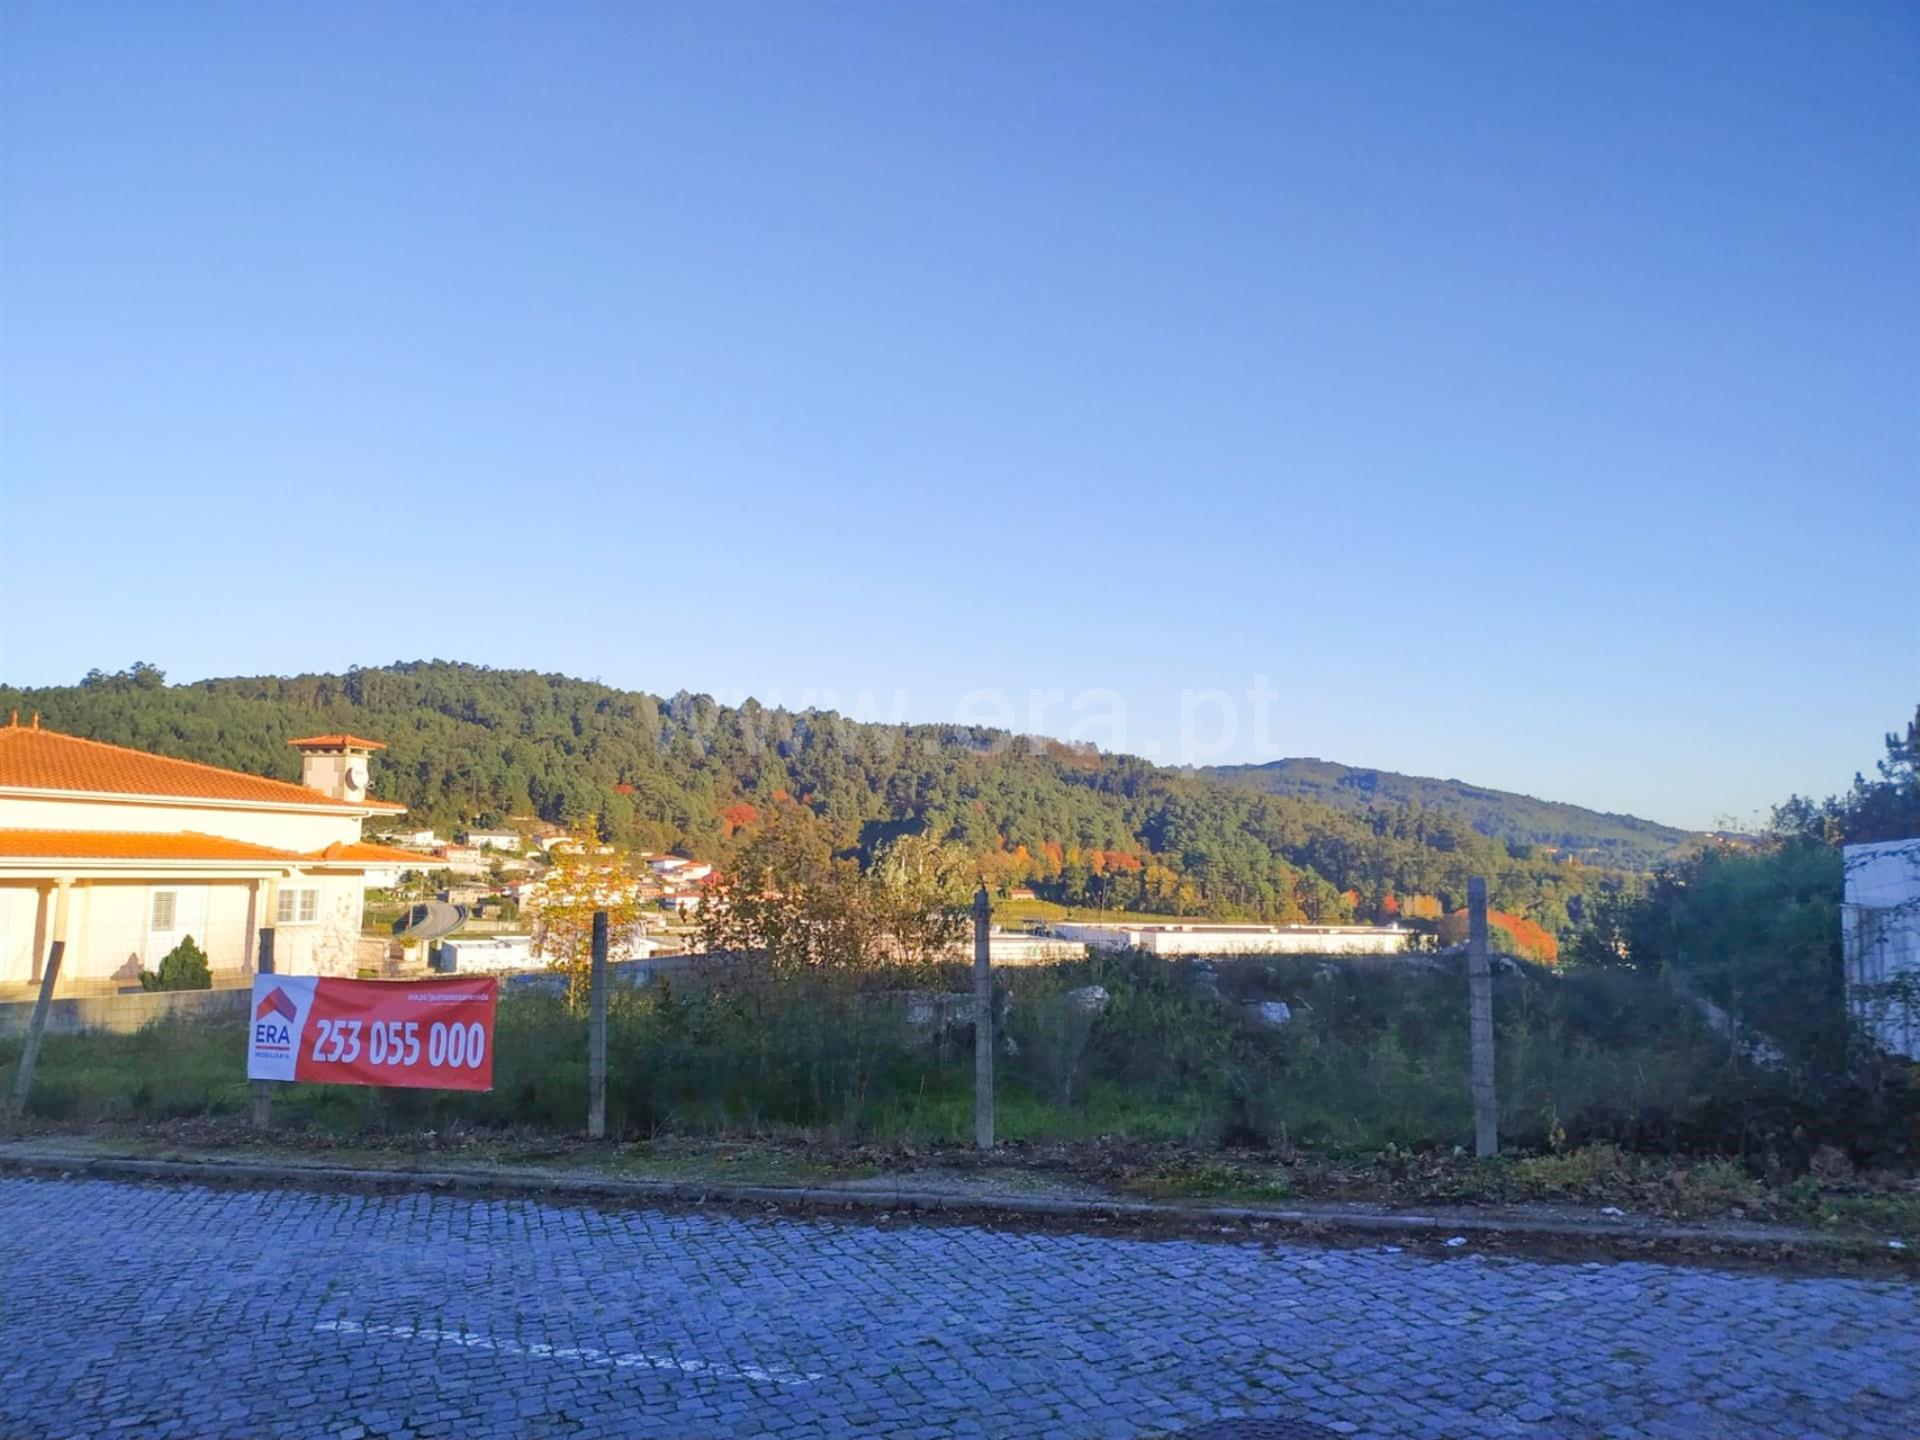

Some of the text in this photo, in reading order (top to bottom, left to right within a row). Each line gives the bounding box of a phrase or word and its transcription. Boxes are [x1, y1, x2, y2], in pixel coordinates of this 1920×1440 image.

[255, 1024, 290, 1044] ERA
[313, 1019, 485, 1068] 253 055 000
